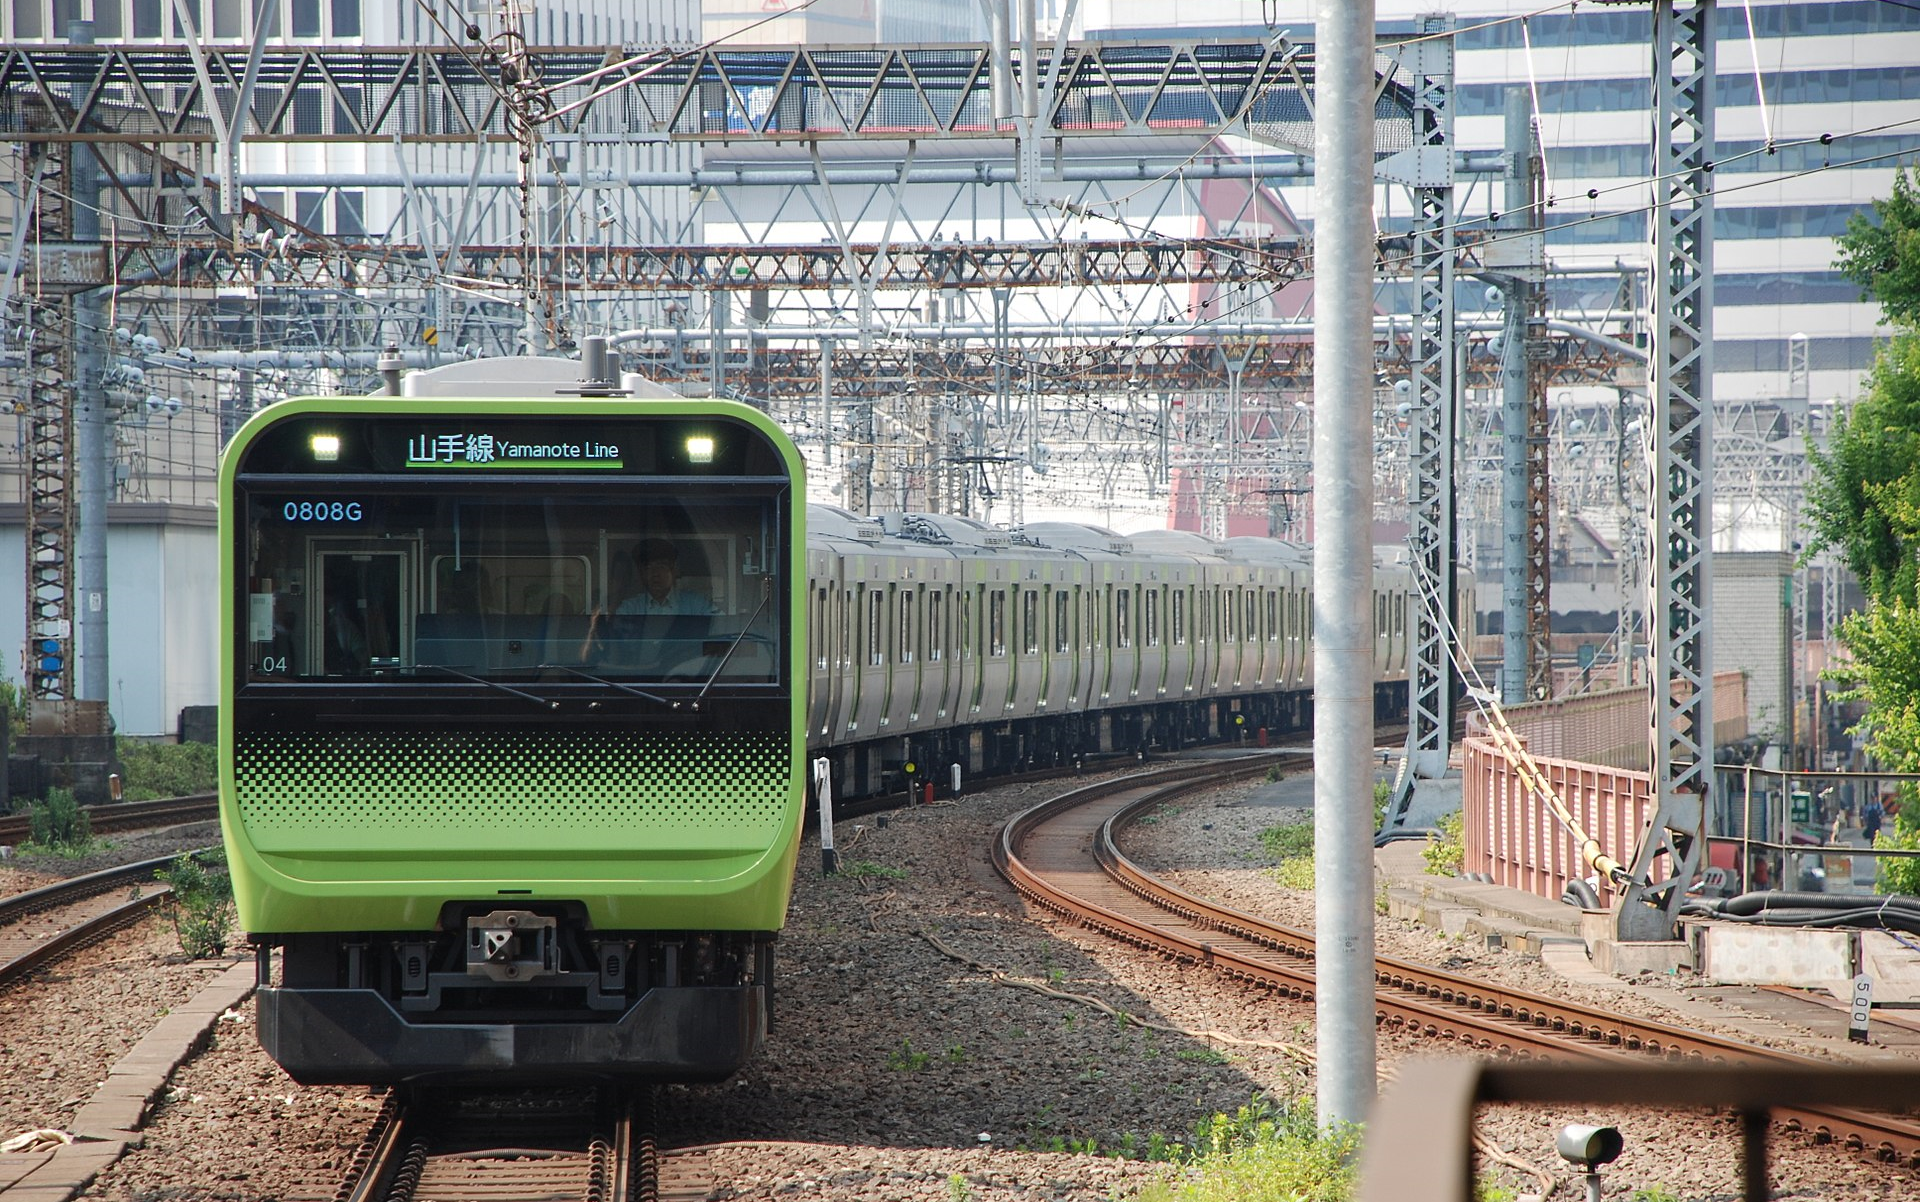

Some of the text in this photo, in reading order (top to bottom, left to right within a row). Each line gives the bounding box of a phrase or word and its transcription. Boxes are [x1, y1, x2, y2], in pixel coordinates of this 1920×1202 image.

[409, 433, 619, 463] 山手線 Yamanote Line
[284, 502, 362, 520] 0808G
[263, 656, 287, 672] 04
[1854, 982, 1869, 1021] 500
